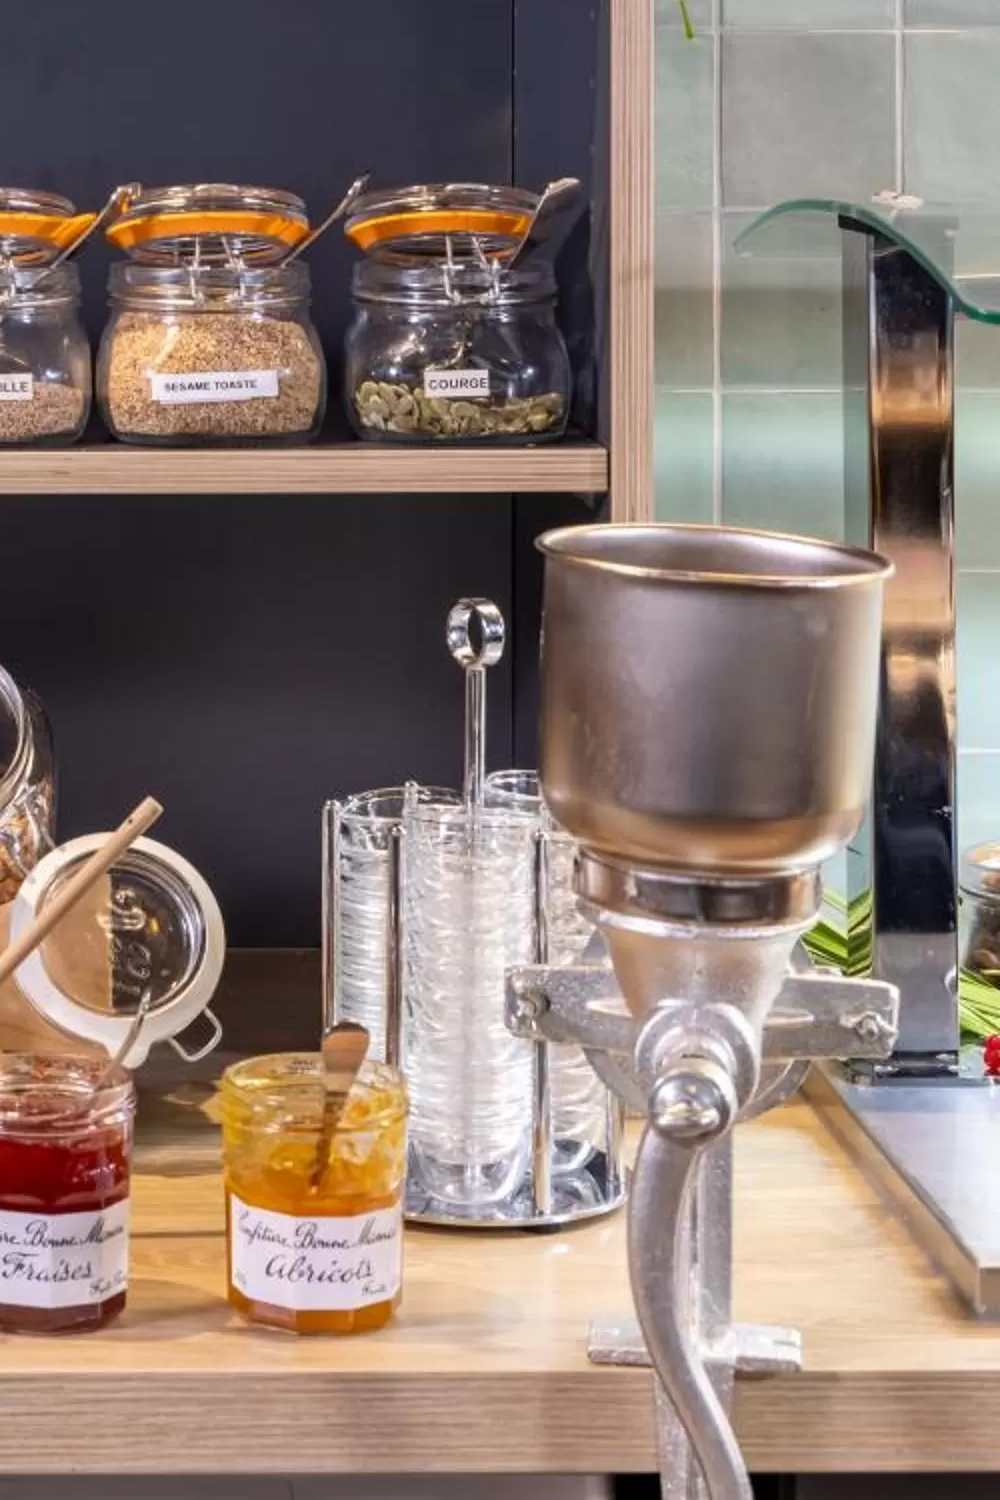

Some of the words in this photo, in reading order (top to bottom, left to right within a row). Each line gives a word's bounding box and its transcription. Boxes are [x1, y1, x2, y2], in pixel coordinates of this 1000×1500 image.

[164, 381, 211, 393] SESAME
[214, 380, 257, 390] TOASTE
[428, 378, 488, 390] COURGE
[24, 1219, 77, 1247] Bonne
[295, 1221, 349, 1249] Bonne
[1, 1251, 93, 1283] Fraises
[265, 1254, 373, 1284] Abricots
